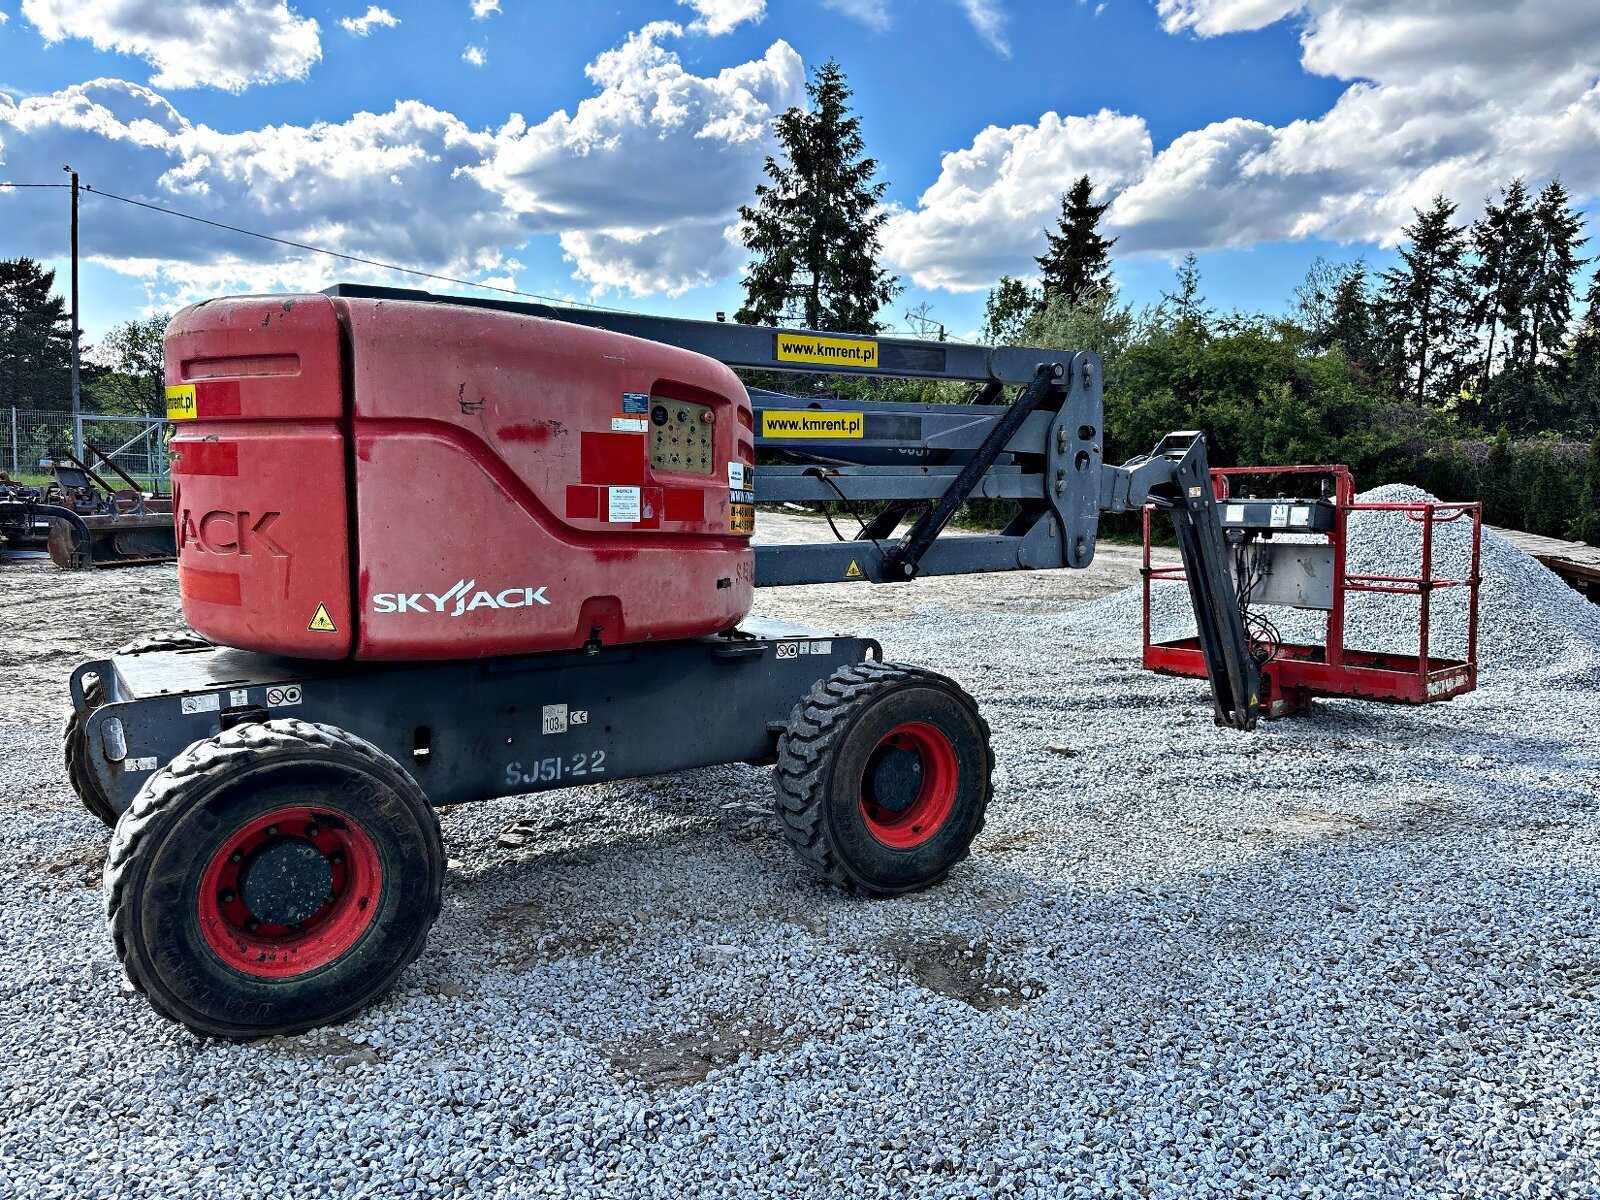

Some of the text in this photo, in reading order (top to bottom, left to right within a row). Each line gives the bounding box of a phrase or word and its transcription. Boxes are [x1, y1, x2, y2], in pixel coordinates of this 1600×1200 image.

[781, 342, 875, 362] www.kmrent.pl
[766, 417, 860, 434] www.kmrent.pl
[372, 578, 551, 617] SKYJACK
[545, 716, 560, 731] 103
